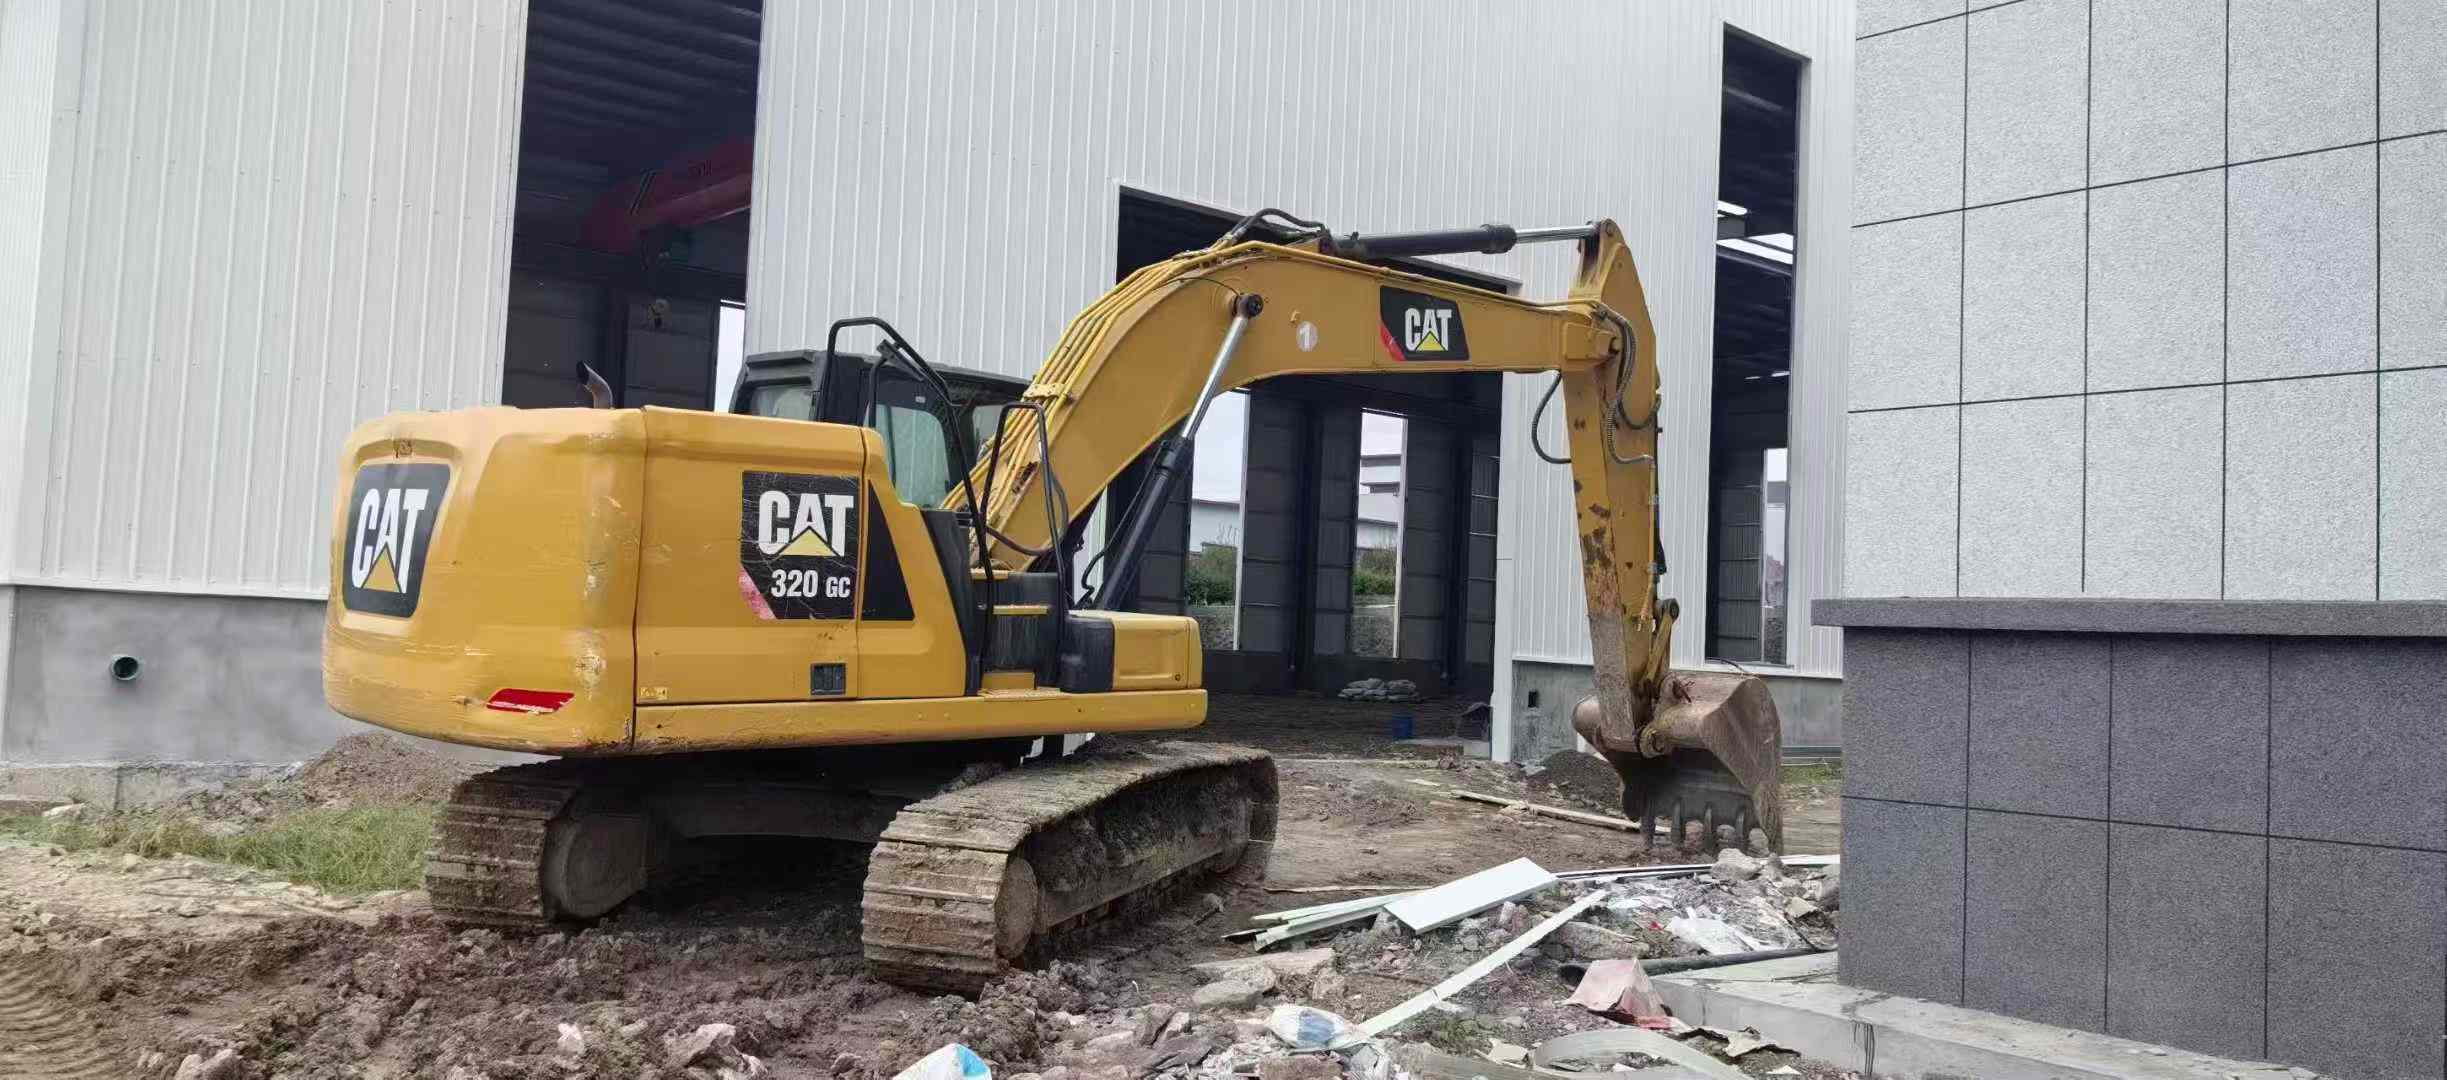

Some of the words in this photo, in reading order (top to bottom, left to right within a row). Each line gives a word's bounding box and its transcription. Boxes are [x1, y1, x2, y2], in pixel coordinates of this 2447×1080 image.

[1405, 308, 1452, 351] CAT
[352, 488, 429, 594] CAT
[758, 490, 854, 557] CAT
[771, 569, 818, 598] 320
[826, 576, 851, 598] GC
